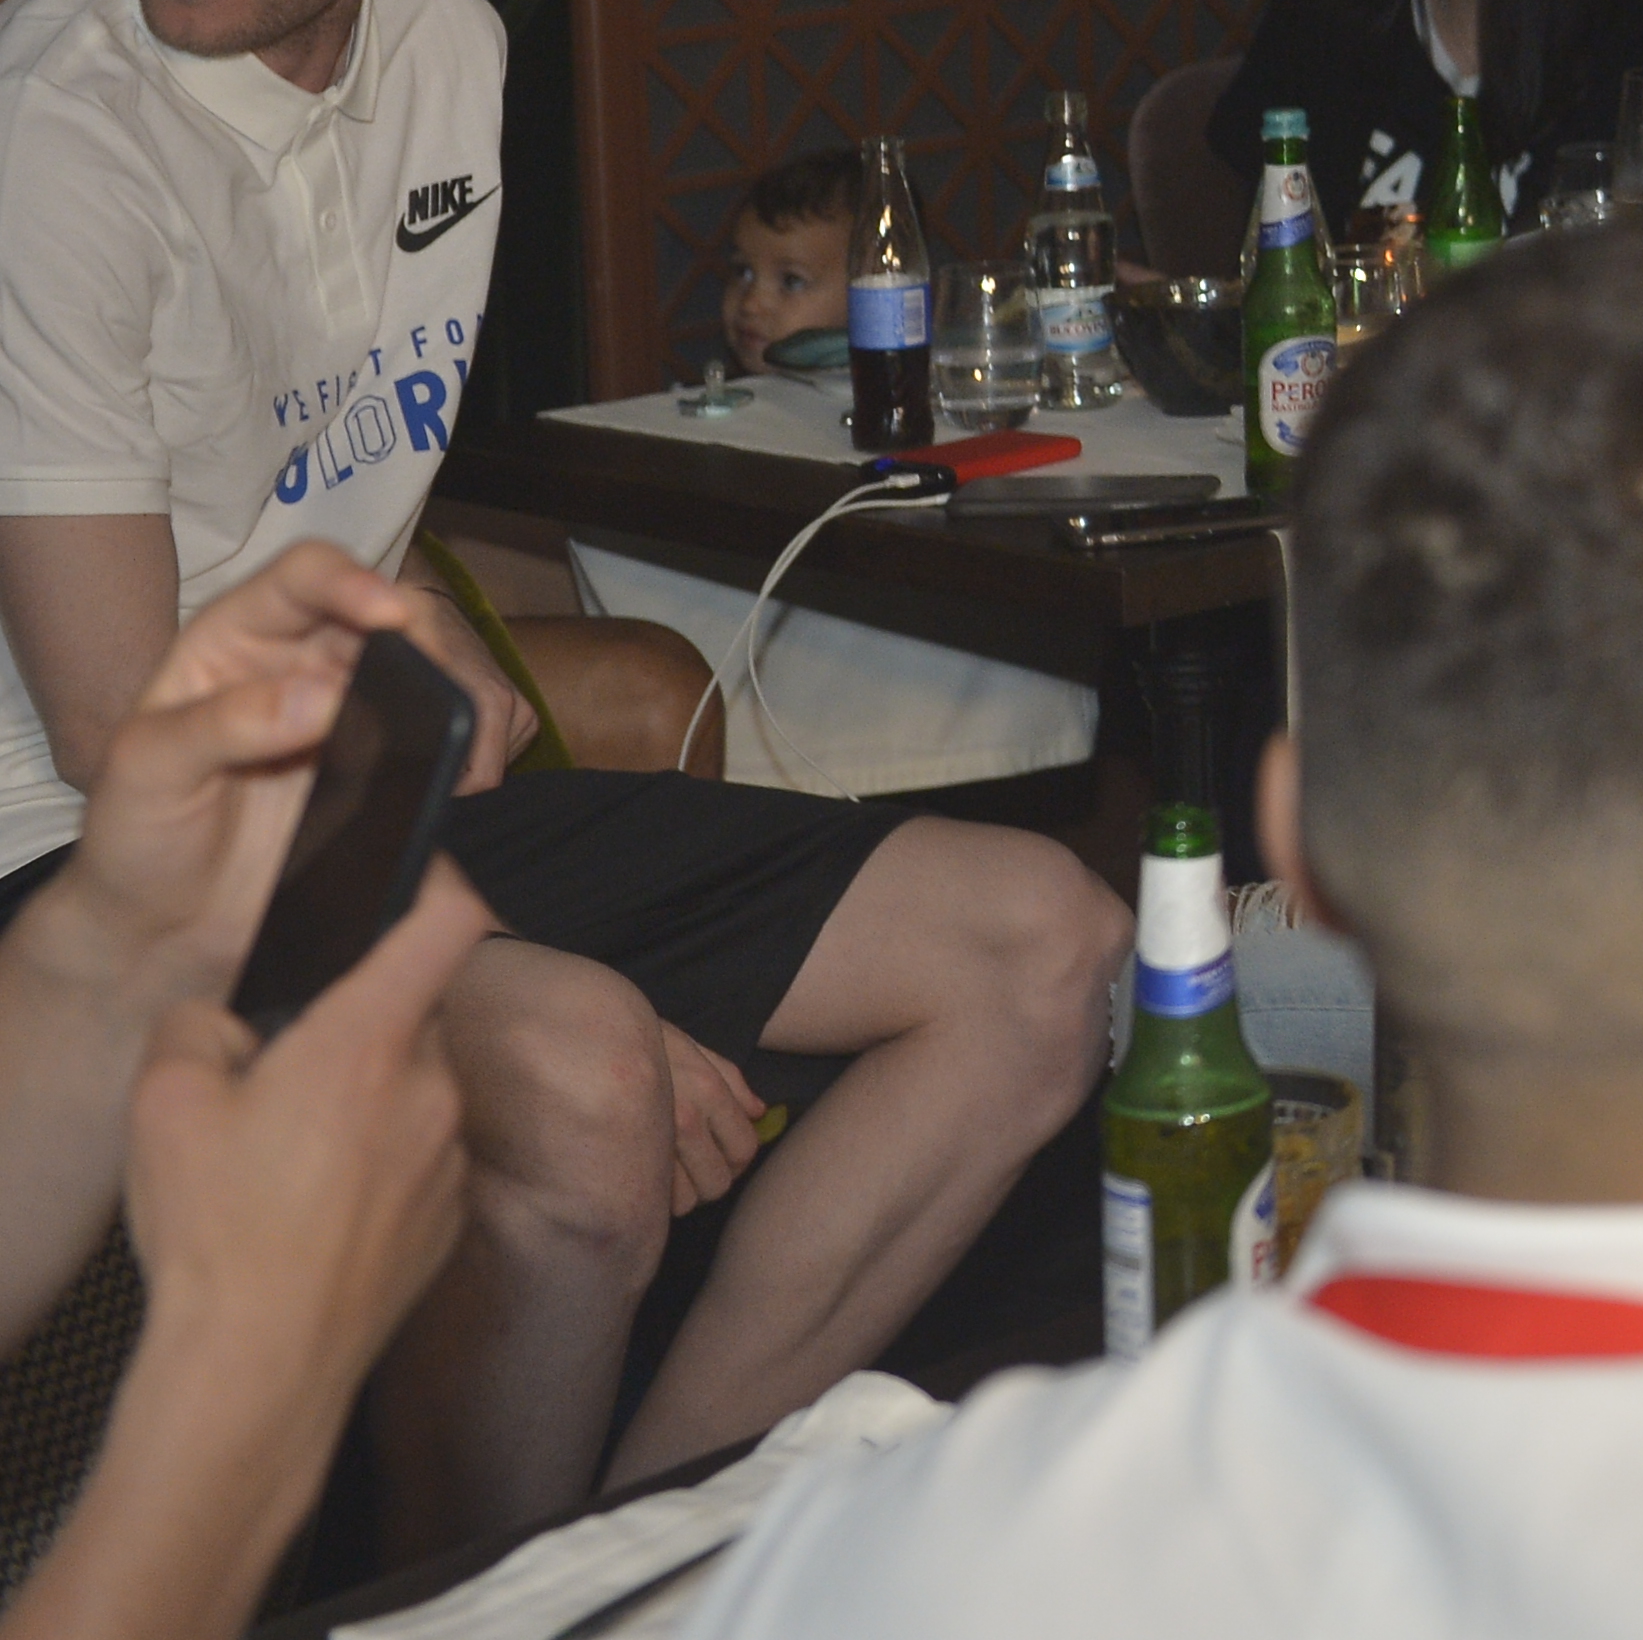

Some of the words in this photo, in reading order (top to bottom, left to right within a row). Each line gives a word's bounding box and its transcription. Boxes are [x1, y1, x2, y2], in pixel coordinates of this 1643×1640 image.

[407, 173, 473, 226] NIKE
[411, 313, 483, 359] FO
[1271, 380, 1326, 401] PERO
